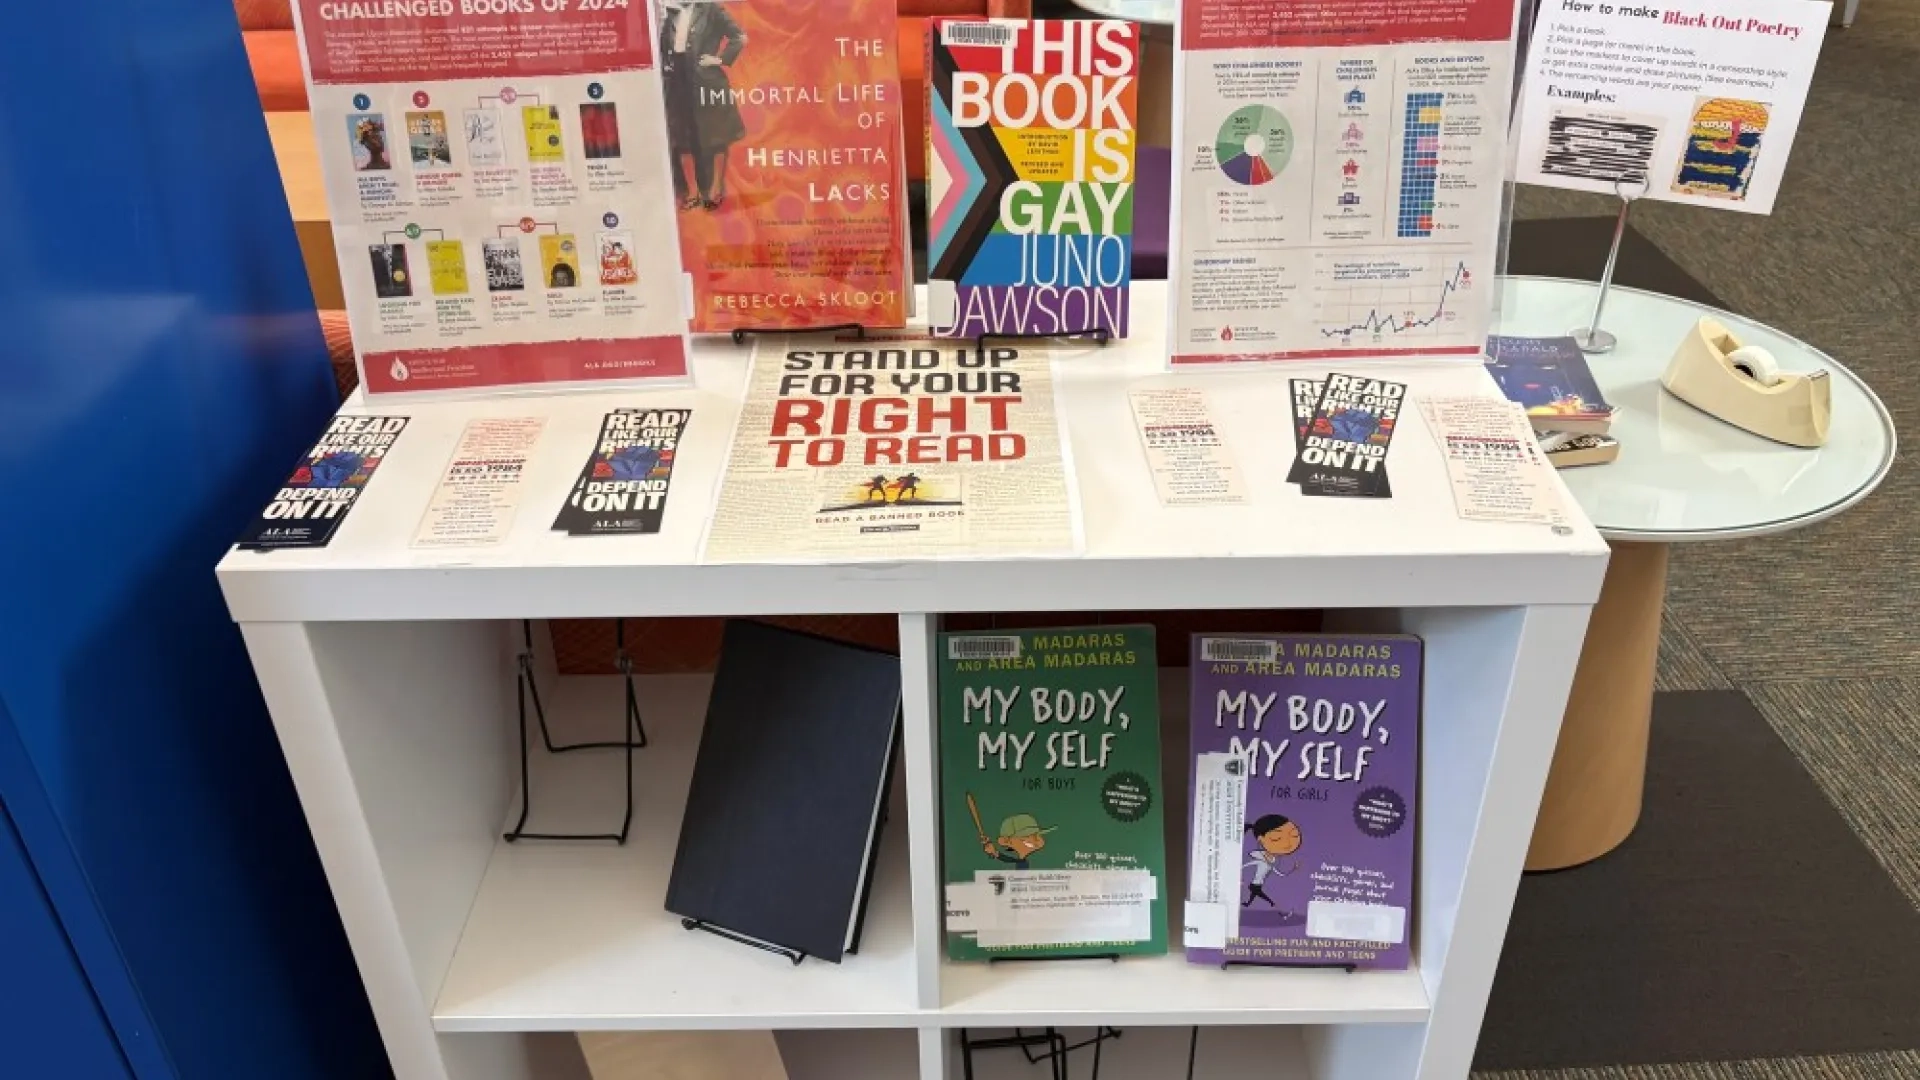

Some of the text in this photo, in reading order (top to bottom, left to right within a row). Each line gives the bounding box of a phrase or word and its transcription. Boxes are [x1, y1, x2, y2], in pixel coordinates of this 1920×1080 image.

[320, 0, 631, 20] CHALLENGED BOOKS OF 2024
[1562, 0, 1802, 41] How to make Black Out Poetry
[835, 37, 884, 57] THE
[989, 18, 1134, 76] THIS
[1553, 47, 1569, 55] Use
[1570, 48, 1584, 57] the
[1657, 45, 1670, 53] the
[700, 82, 885, 106] IMMORTAL LIFE
[952, 71, 1133, 130] BOOK
[1547, 84, 1617, 104] Examples:
[858, 112, 885, 129] OF
[748, 147, 888, 167] HENRIETTA
[1073, 129, 1130, 183] IS
[809, 182, 890, 203] LACKS
[1000, 180, 1131, 236] GAY
[1013, 234, 1125, 287] JUNO
[713, 291, 896, 309] REBECCA SKLOOT
[785, 349, 1018, 371] STAND UP
[779, 372, 1021, 396] FOR YOUR
[1328, 375, 1404, 397] READ
[1326, 389, 1399, 409] LIKE OUR
[327, 418, 406, 433] READ
[606, 412, 681, 429] READ
[770, 396, 1021, 436] RIGHT
[320, 433, 395, 445] LIKE OUR
[604, 428, 678, 439] LIKE OUR
[768, 434, 1026, 467] TO READ
[1305, 436, 1386, 458] DEPEND
[1301, 447, 1384, 472] ON IT
[274, 487, 356, 500] DEPEND
[587, 480, 667, 493] DEPEND
[262, 501, 349, 519] ON IT
[582, 492, 666, 511] ON IT
[870, 513, 922, 521] BANNED
[1034, 633, 1125, 650] MADARAS
[1295, 644, 1391, 659] MADARAS
[956, 651, 1136, 672] AND AREA MADARAS
[1211, 662, 1401, 679] AND AREA MADARAS
[963, 685, 1130, 730] MY BODY,
[1215, 690, 1389, 744] MY BODY,
[978, 730, 1117, 770] MY SELF
[1229, 736, 1374, 782] MY SELF
[1022, 777, 1076, 791] FOR BOYS
[1270, 785, 1329, 801] FOR GIRLS
[1290, 938, 1308, 947] FUN
[1312, 939, 1331, 948] AND
[1253, 949, 1272, 957] FOR
[1274, 949, 1322, 959] PRETEENS
[1325, 950, 1344, 959] AND
[1347, 951, 1376, 960] TEENS
